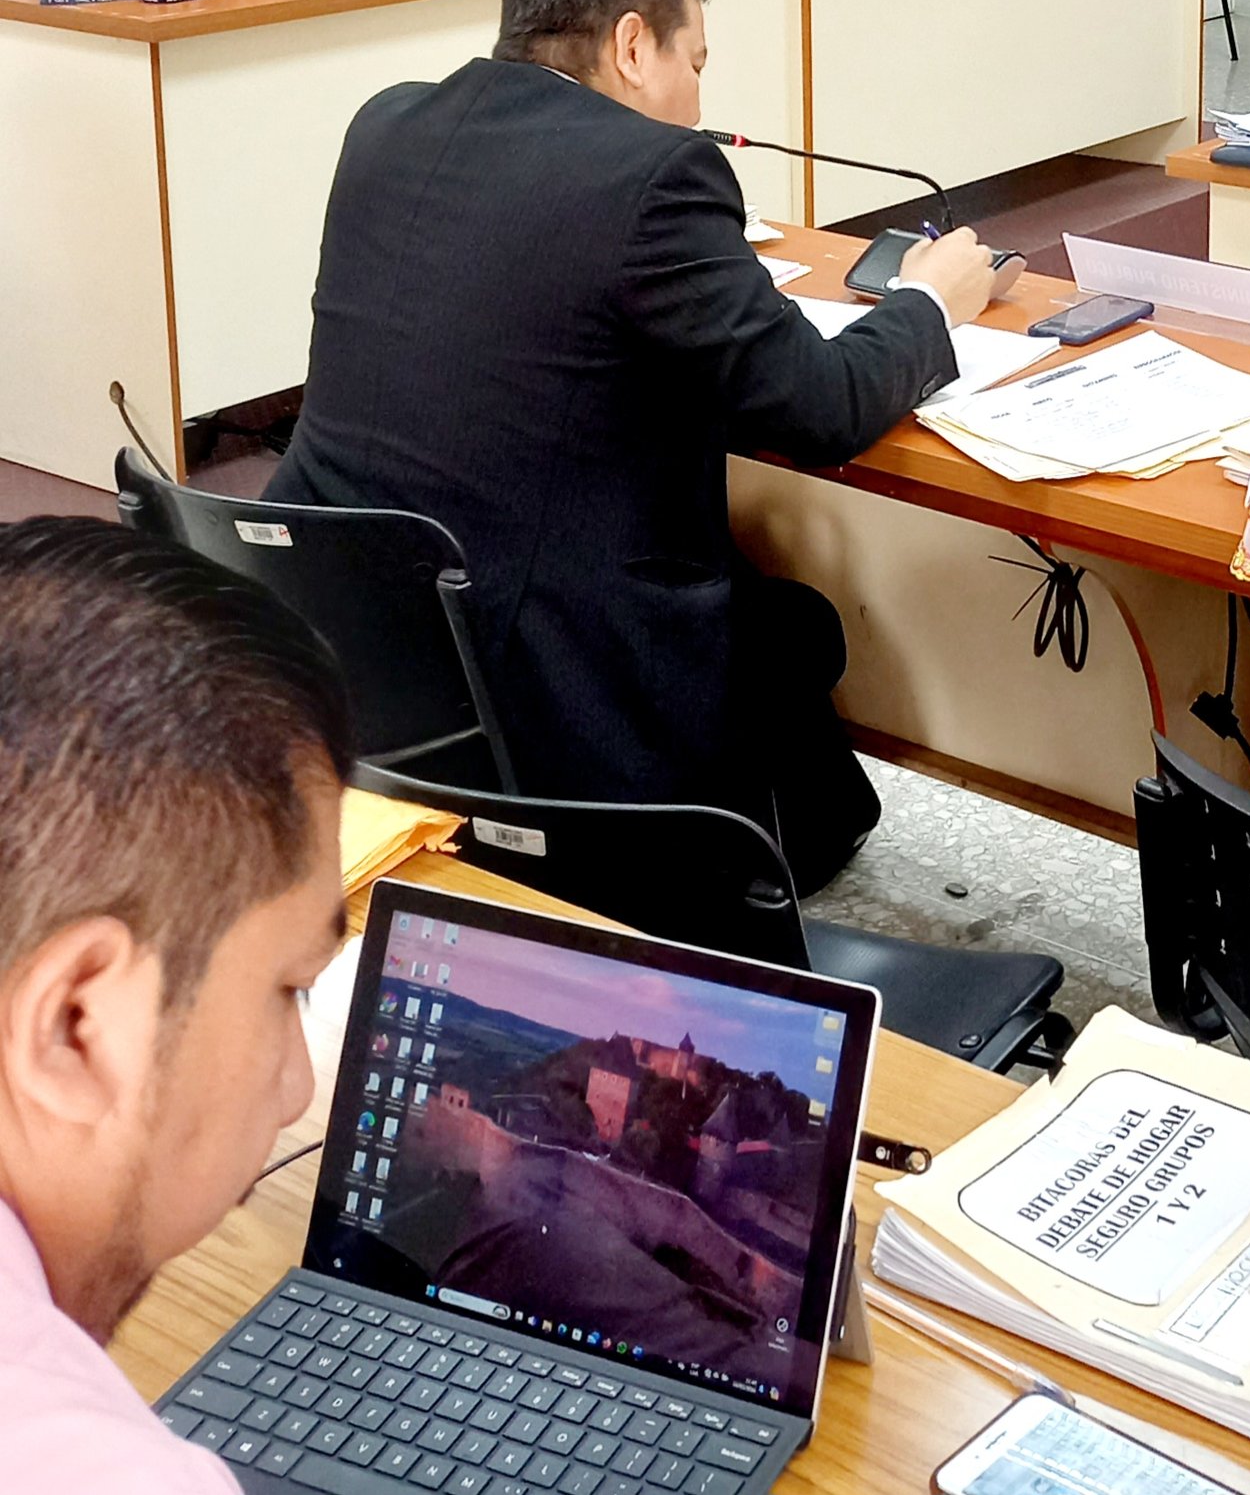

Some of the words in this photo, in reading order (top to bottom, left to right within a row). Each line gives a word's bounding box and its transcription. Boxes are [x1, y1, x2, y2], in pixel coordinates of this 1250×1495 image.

[1017, 1141, 1116, 1223] BITACORAS
[1108, 1108, 1151, 1140] DEL
[1035, 1188, 1111, 1250] DEBATE
[1101, 1164, 1137, 1190] DE
[1126, 1104, 1191, 1165] HOGAR
[1076, 1194, 1151, 1259] SEGURO
[1145, 1123, 1216, 1193] GRUPOS
[1156, 1214, 1176, 1227] 1
[1167, 1197, 1191, 1212] Y
[1183, 1184, 1207, 1199] 2
[286, 1347, 297, 1357] Q
[318, 1357, 331, 1367] W
[385, 1378, 395, 1388] R
[420, 1389, 428, 1398] T
[453, 1399, 463, 1409] Y
[487, 1410, 498, 1420] U
[556, 1432, 568, 1442] O
[332, 1397, 343, 1408] D
[400, 1420, 411, 1430] G
[434, 1430, 445, 1440] H
[504, 1453, 515, 1464] K
[324, 1432, 335, 1443] C
[427, 1465, 438, 1476] N
[460, 1477, 474, 1488] M
